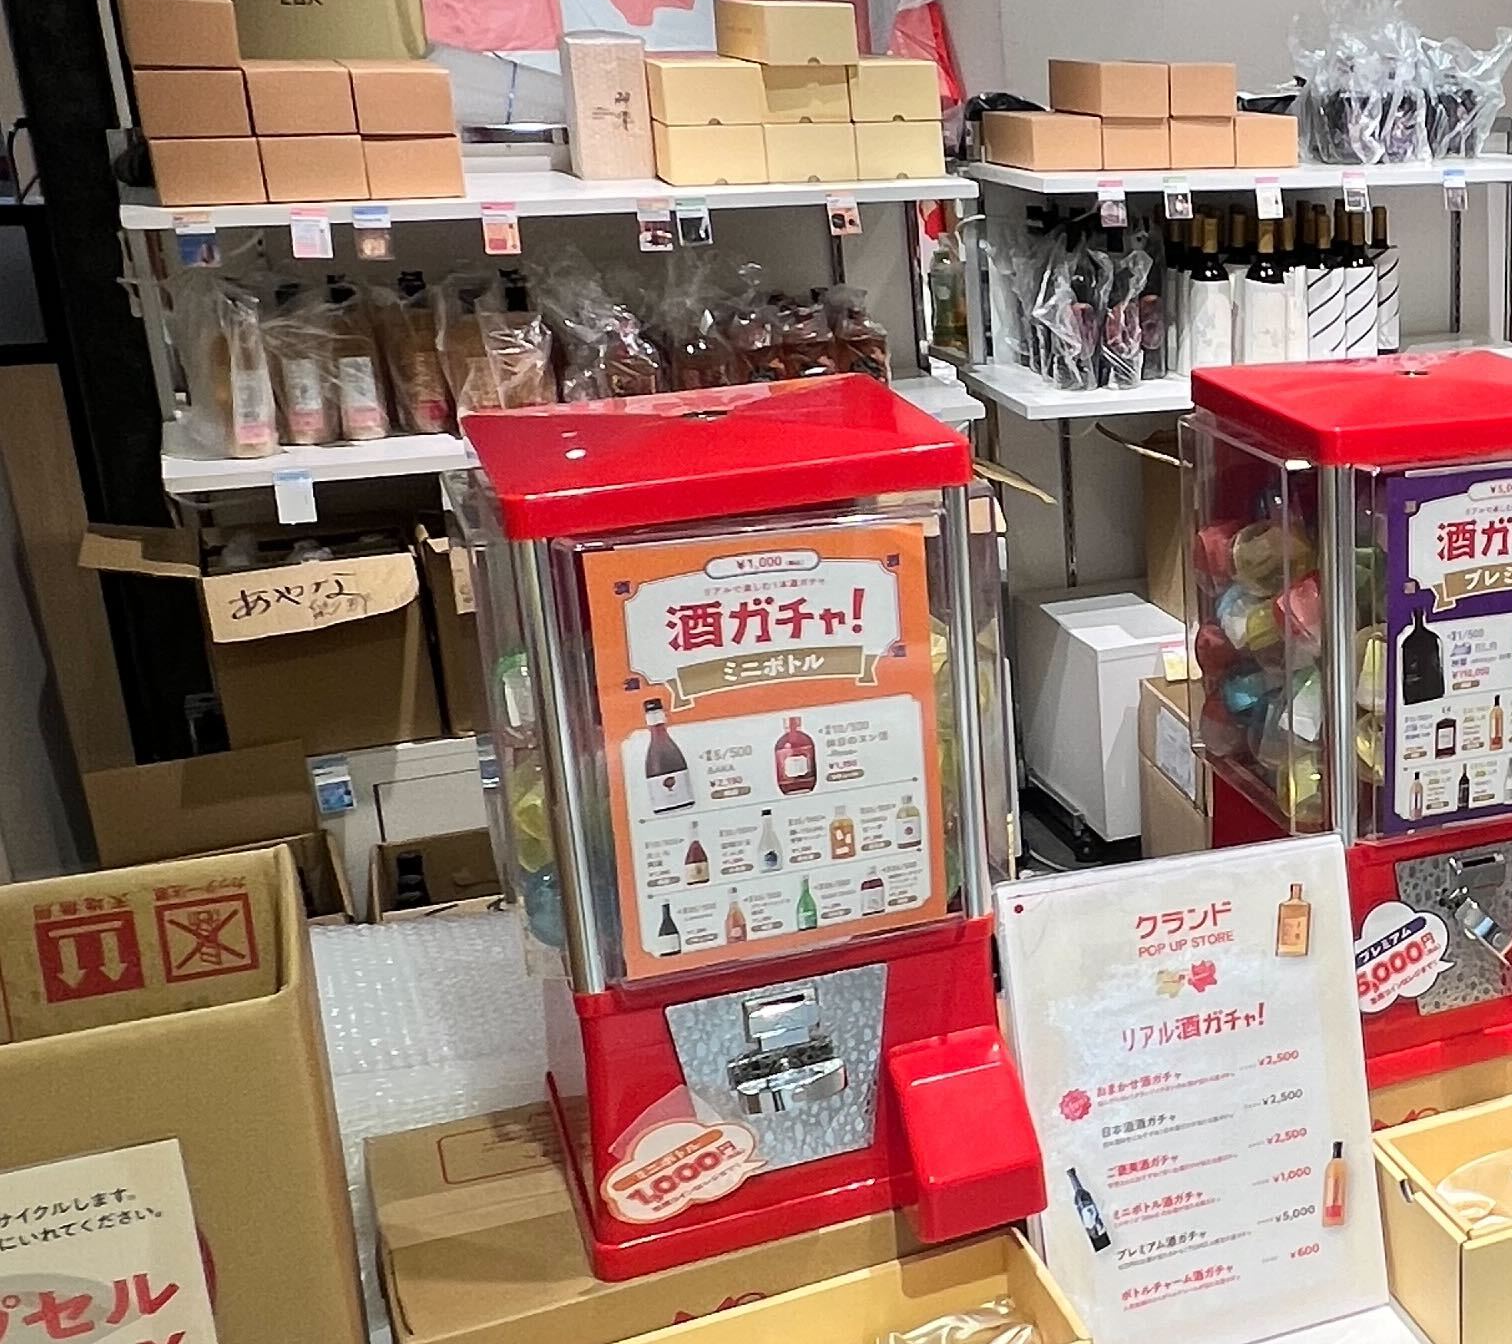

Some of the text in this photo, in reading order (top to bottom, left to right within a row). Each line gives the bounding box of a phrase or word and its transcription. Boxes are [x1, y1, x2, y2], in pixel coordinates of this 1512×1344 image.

[665, 587, 867, 652] 酒ガチャ!
[722, 654, 826, 682] ミニボトル
[1135, 900, 1233, 940] クランド
[1138, 930, 1235, 958] POP UP STORE
[1262, 1088, 1304, 1106] ¥2,500
[1266, 1127, 1308, 1146] ¥2,500
[1272, 1166, 1313, 1184] ¥1,000
[1275, 1205, 1317, 1224] ¥5,000
[1290, 1243, 1321, 1260] ¥600
